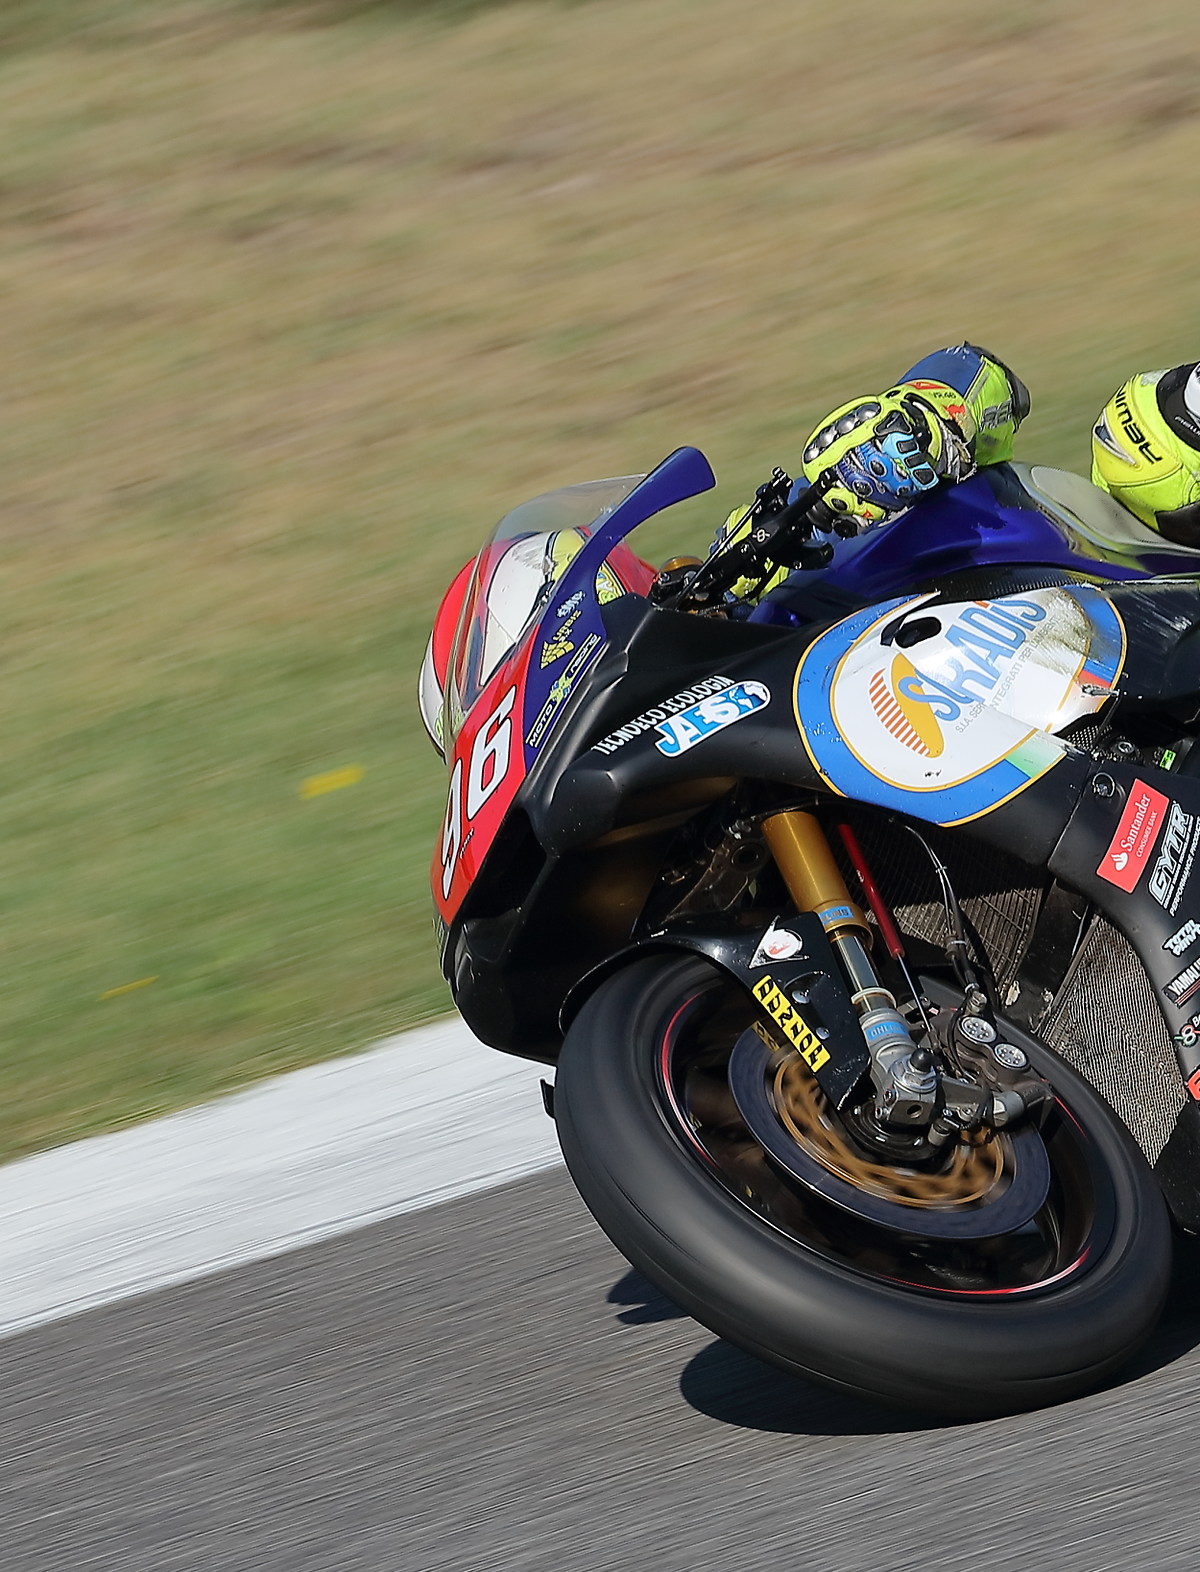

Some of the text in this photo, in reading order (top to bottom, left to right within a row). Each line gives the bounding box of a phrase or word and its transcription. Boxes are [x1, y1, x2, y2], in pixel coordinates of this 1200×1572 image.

[552, 609, 582, 640] URBIS
[990, 660, 1023, 709] NTEGRATI
[1018, 646, 1035, 662] PER
[529, 703, 554, 747] MOTO
[590, 675, 735, 756] TECNOECO ECOLOGIA
[658, 695, 741, 754] JAES
[441, 684, 517, 900] 96
[1121, 794, 1151, 852] Santander
[1136, 811, 1158, 858] CONSUMER BANK
[1150, 803, 1190, 906] GYTR
[1169, 854, 1194, 917] PERFORMANCE
